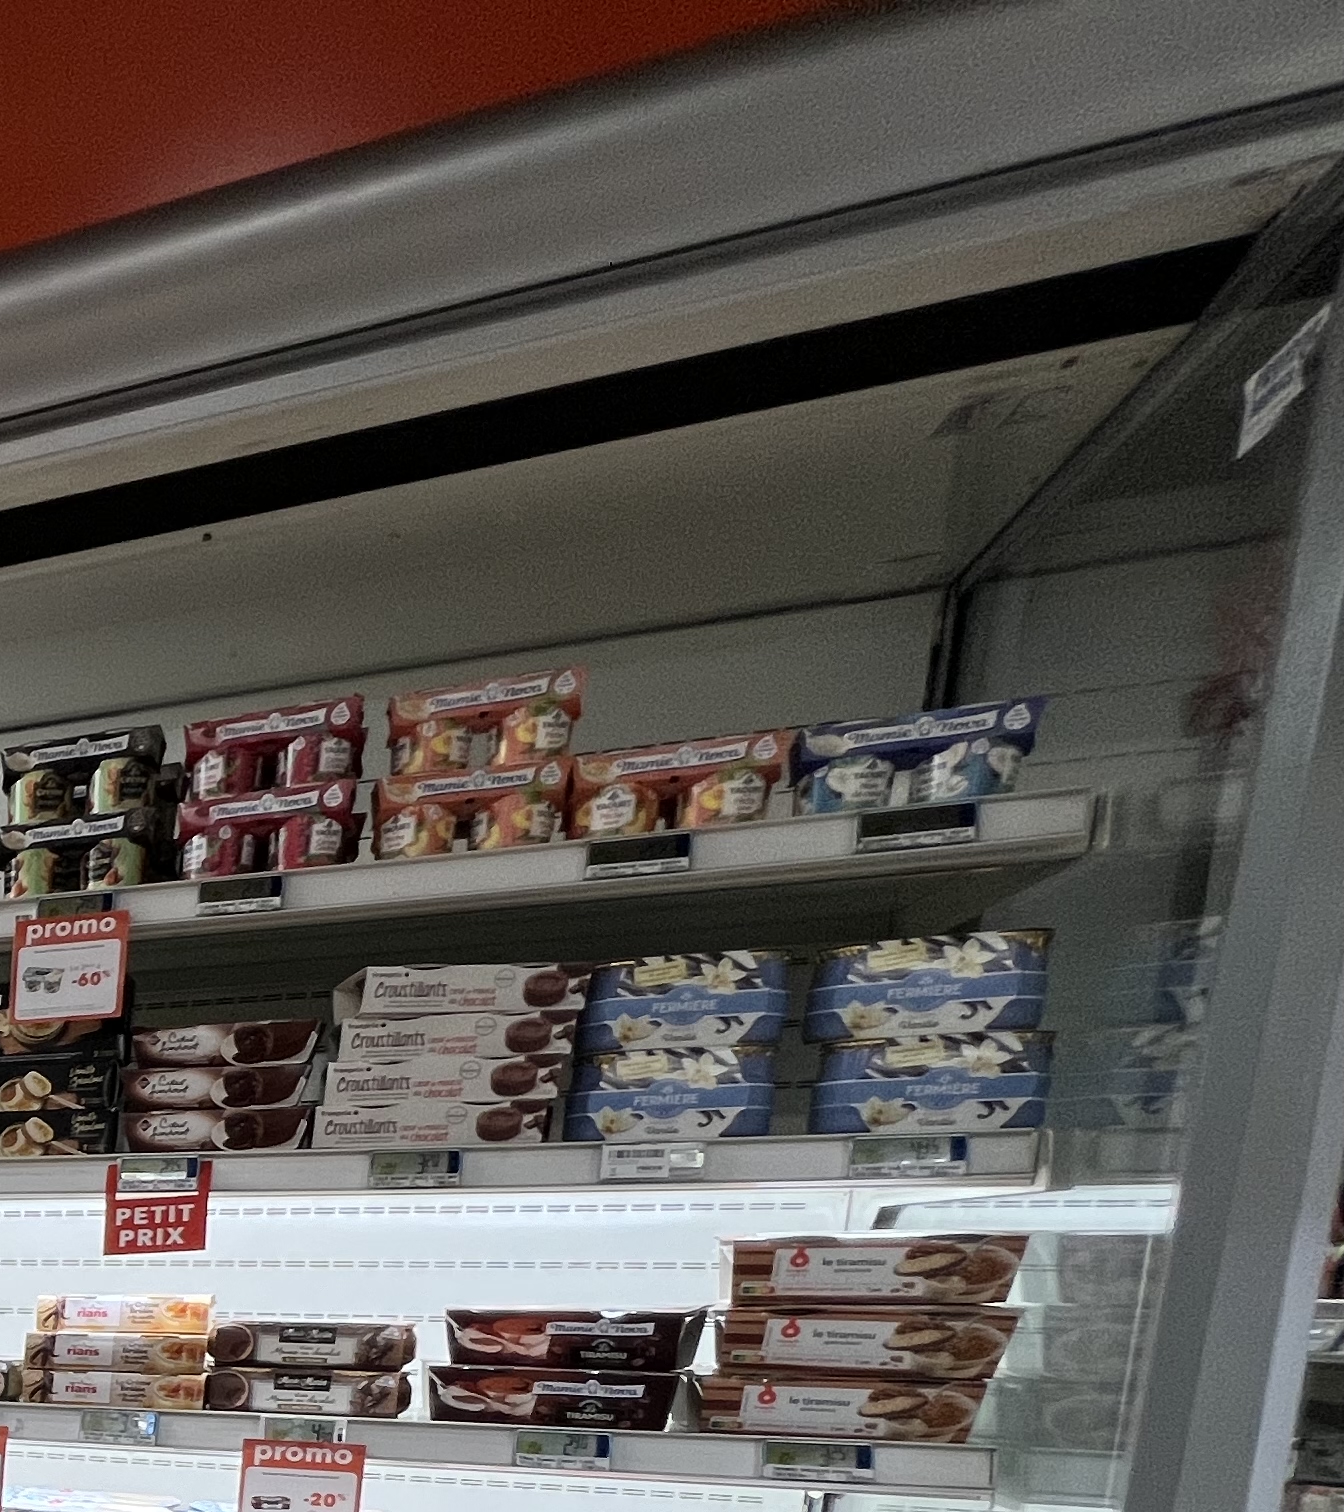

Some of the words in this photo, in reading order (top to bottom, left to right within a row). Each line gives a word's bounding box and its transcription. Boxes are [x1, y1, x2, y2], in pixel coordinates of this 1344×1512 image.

[25, 917, 117, 945] promo
[374, 982, 448, 998] Croustillants
[351, 1032, 425, 1049] Croustillants
[337, 1076, 410, 1092] Croustillants
[324, 1119, 397, 1135] Croustillants
[116, 1204, 195, 1226] PETIT
[119, 1227, 184, 1248] PRIX
[835, 1258, 887, 1267] tiramisu
[77, 1308, 108, 1319] rians
[552, 1324, 592, 1333] Mamie
[827, 1330, 877, 1340] tiramisu
[66, 1345, 99, 1357] rians
[64, 1383, 97, 1394] rians
[539, 1382, 582, 1394] Mamie
[802, 1397, 851, 1407] tiramisu
[254, 1445, 353, 1465] promo
